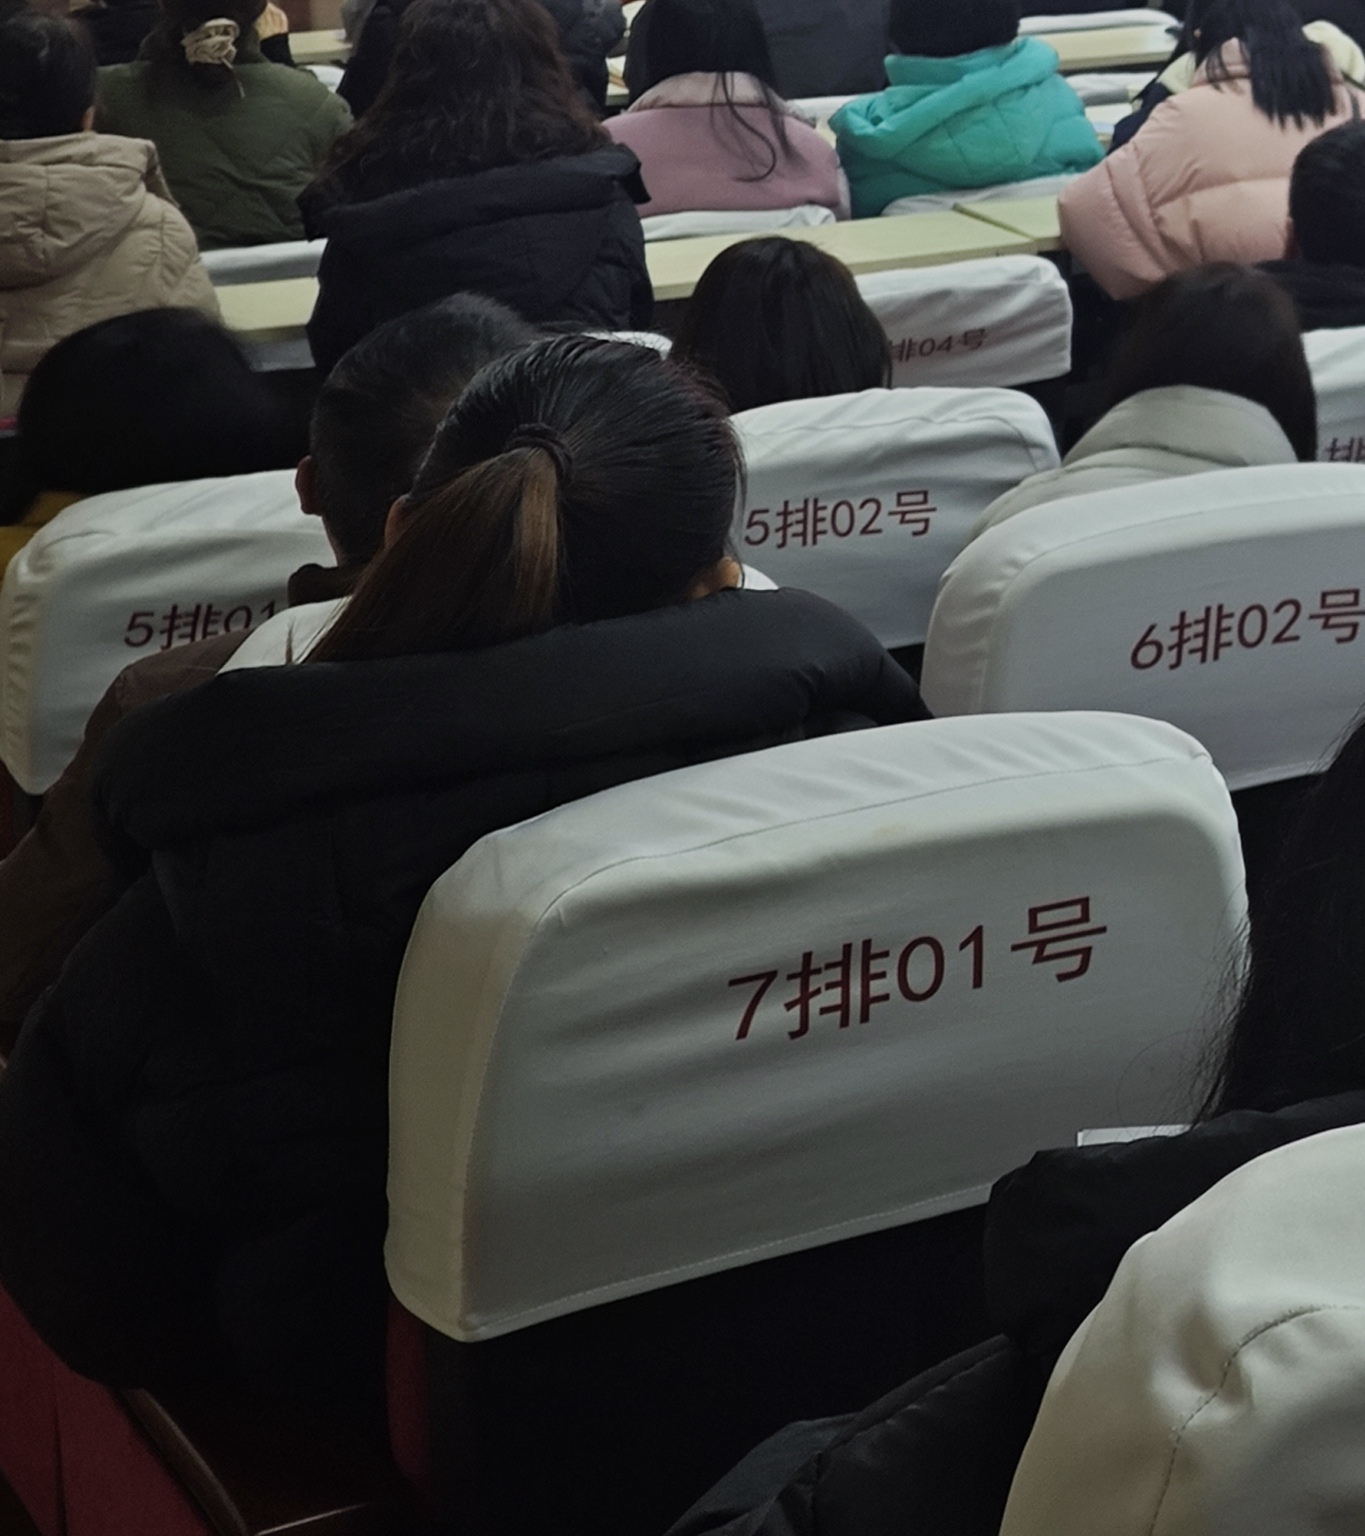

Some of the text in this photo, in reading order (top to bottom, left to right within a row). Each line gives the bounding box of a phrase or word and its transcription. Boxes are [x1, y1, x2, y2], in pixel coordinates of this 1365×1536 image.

[889, 328, 986, 362] 排04号
[744, 490, 937, 549] 5排02号
[124, 600, 276, 650] 5排01
[728, 896, 1107, 1041] 7排01号
